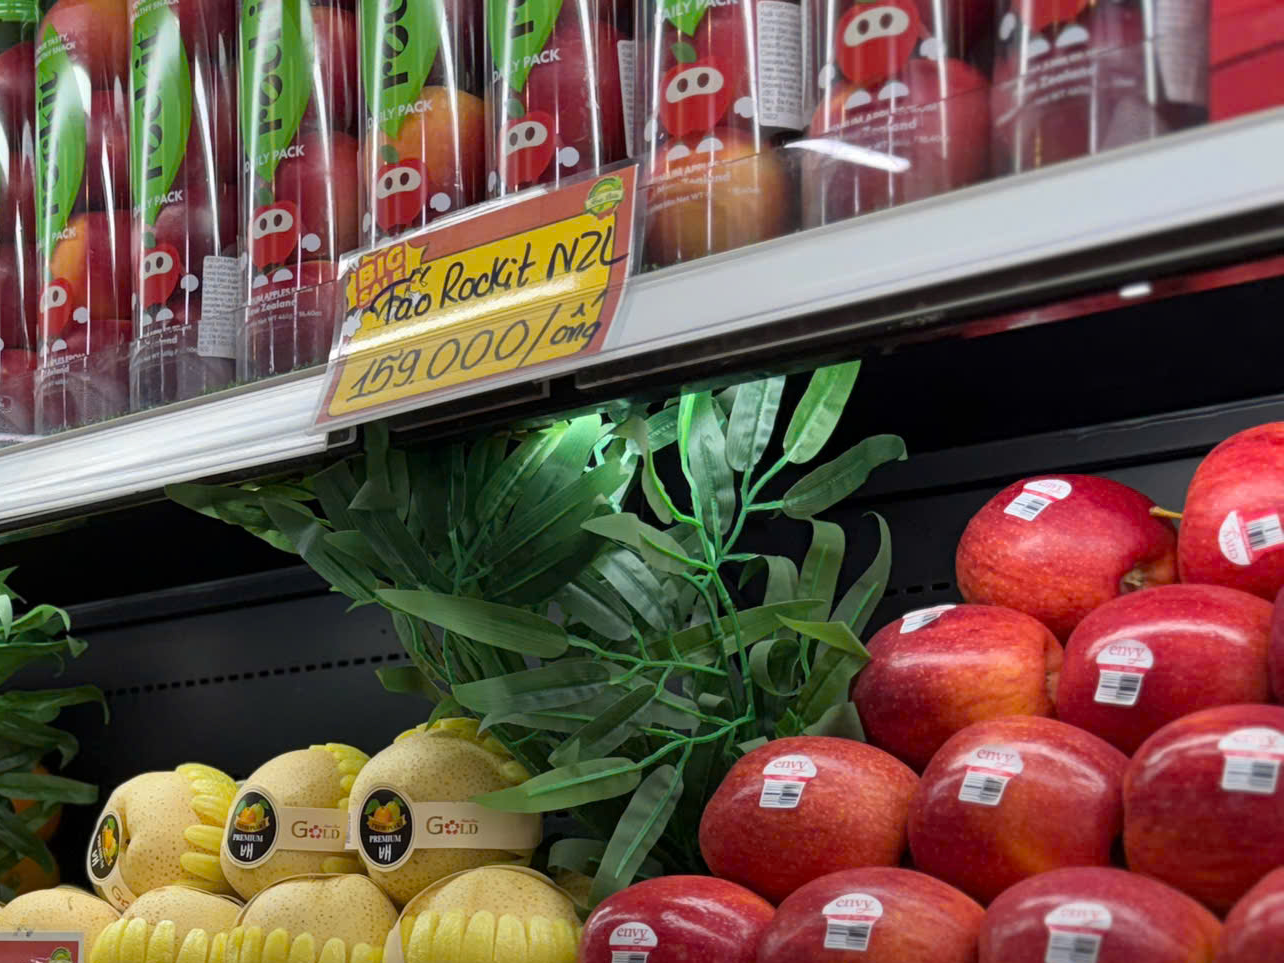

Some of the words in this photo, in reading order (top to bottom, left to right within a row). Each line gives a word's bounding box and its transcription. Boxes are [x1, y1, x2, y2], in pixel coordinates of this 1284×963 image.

[662, 1, 692, 19] AILY
[523, 47, 562, 68] PACK
[248, 0, 283, 136] rocki
[367, 108, 396, 130] DILY
[398, 100, 433, 115] PACK
[272, 145, 306, 161] PACK
[152, 190, 184, 206] PACK
[52, 227, 77, 241] PACK
[1109, 642, 1145, 663] envy
[976, 747, 1016, 768] envy
[233, 833, 264, 843] PREMIUM
[369, 834, 402, 844] PREMIUM
[834, 896, 874, 914] envy
[616, 925, 651, 944] envy
